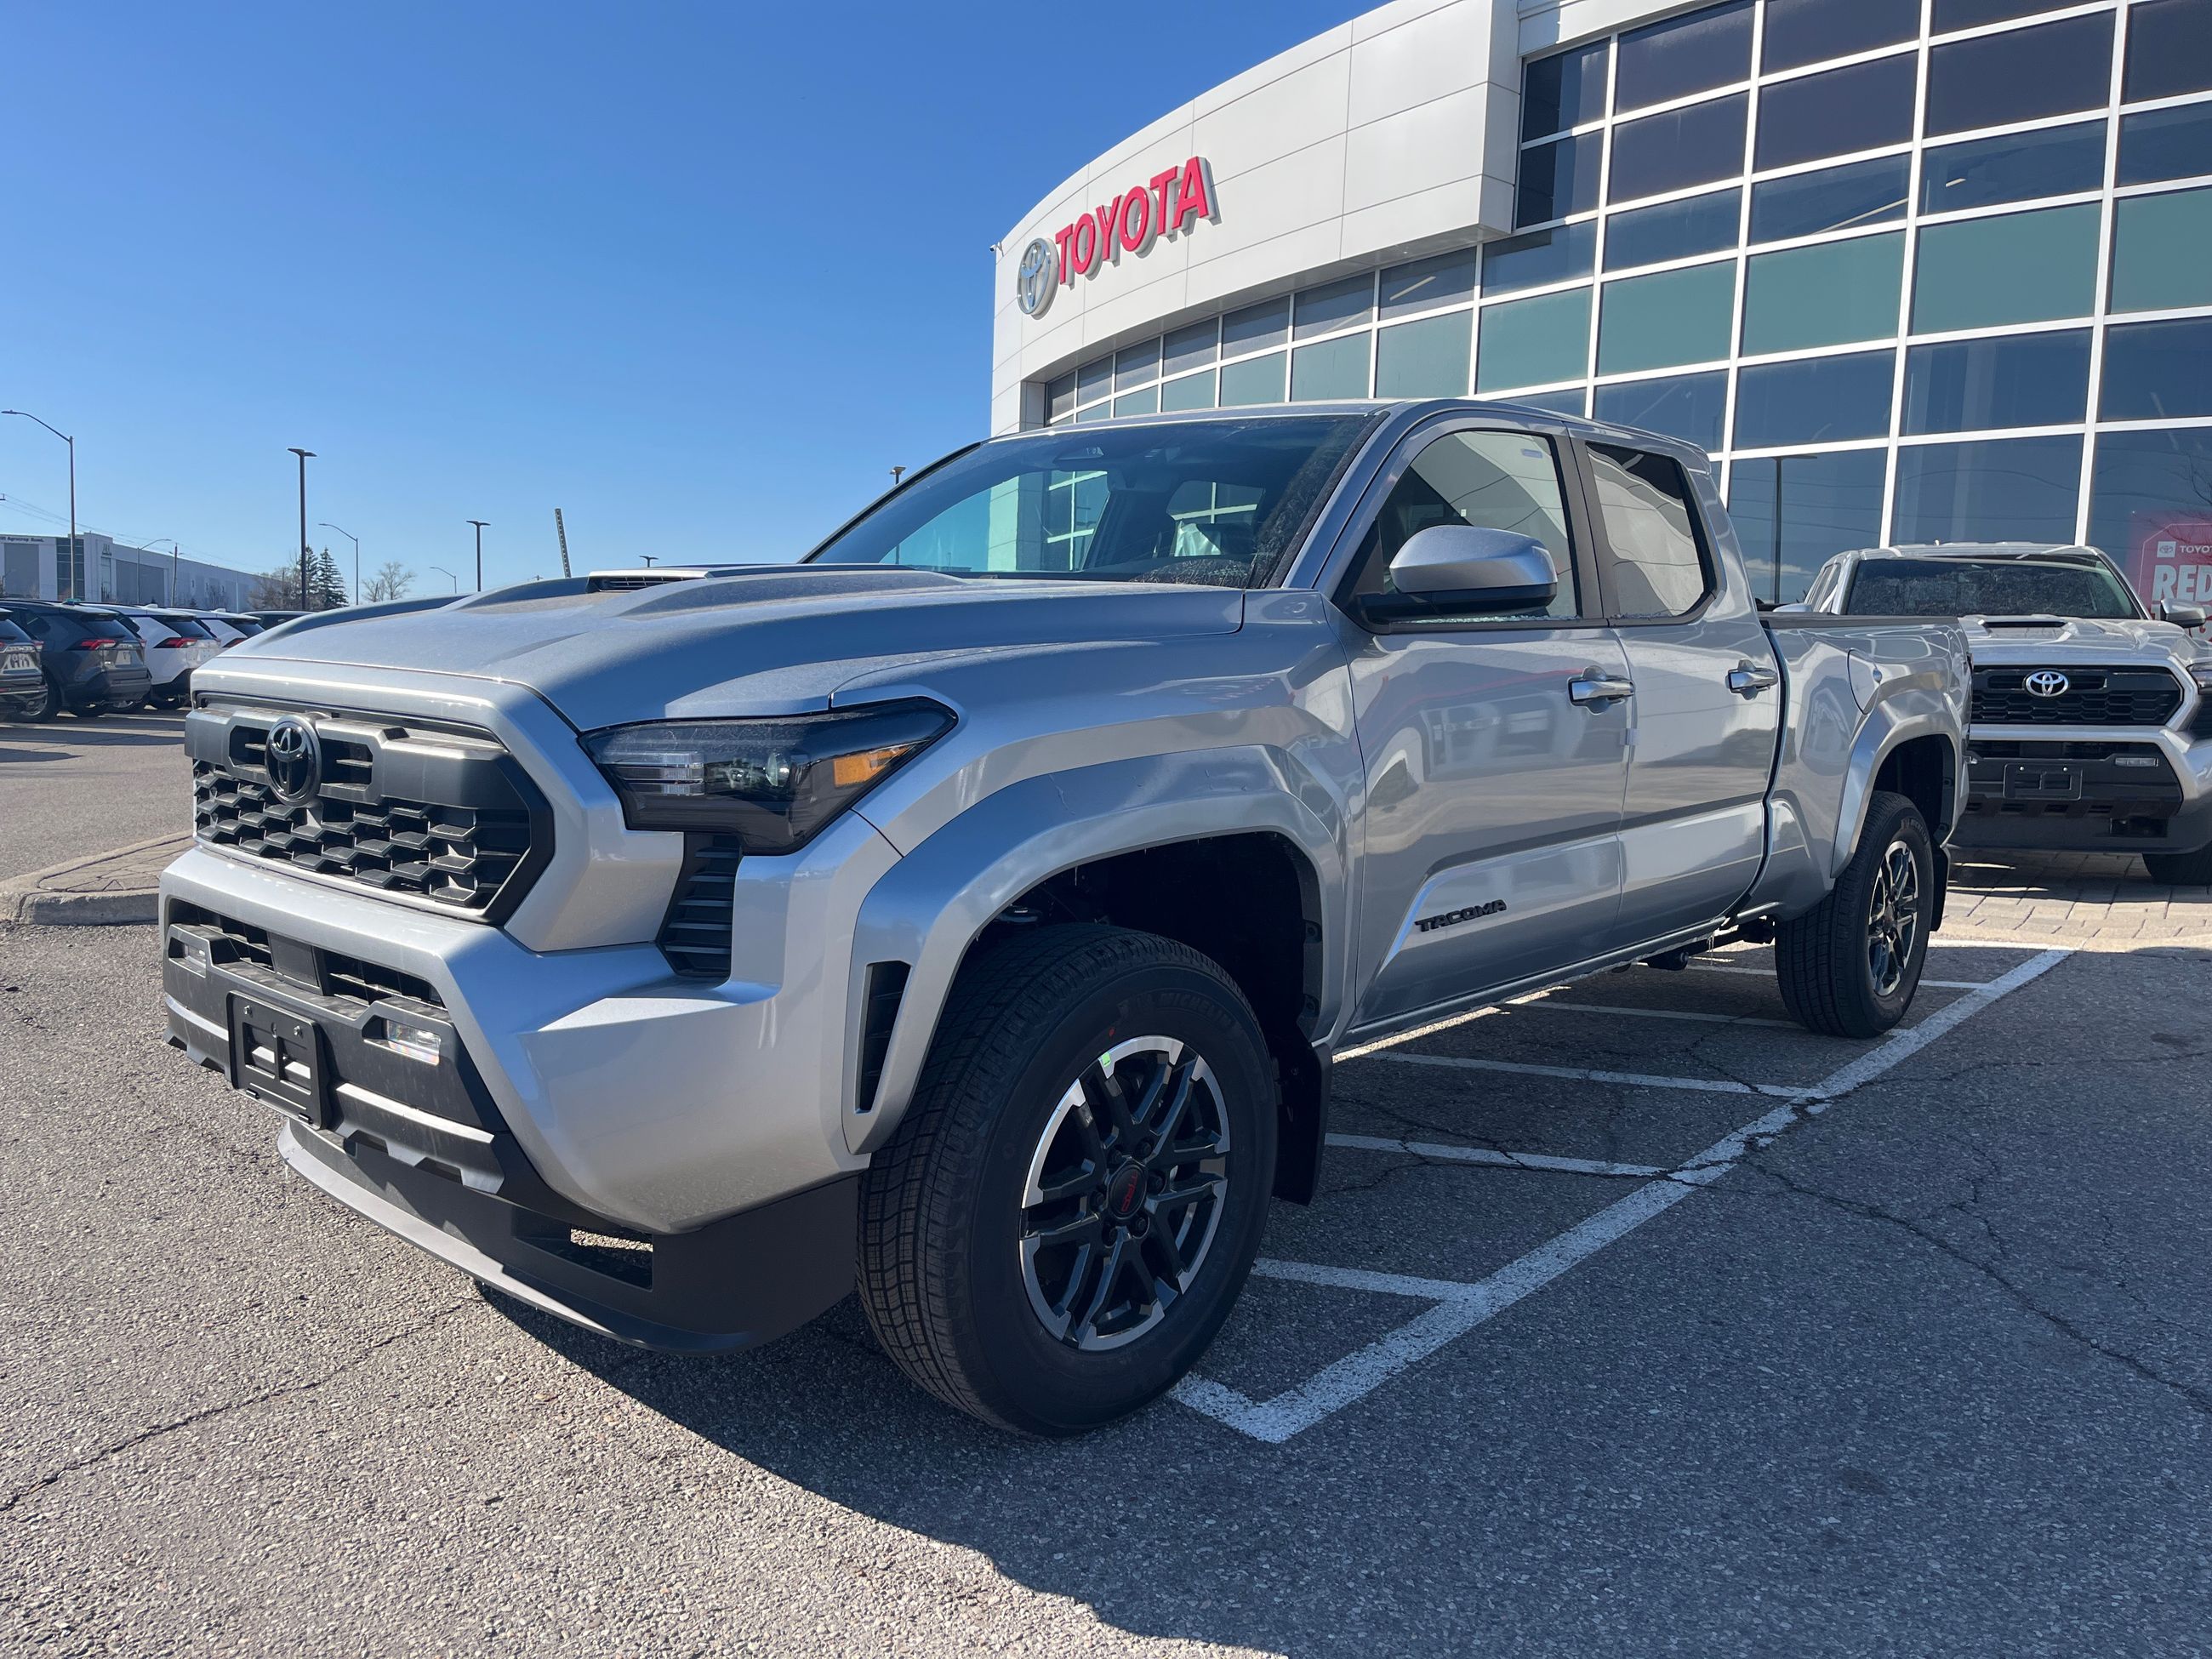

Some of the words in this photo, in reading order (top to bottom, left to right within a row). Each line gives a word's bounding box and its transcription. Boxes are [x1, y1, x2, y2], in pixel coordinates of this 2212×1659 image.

[1055, 156, 1211, 287] TOYOTA
[2180, 545, 2212, 554] TOYO
[2152, 565, 2212, 601] RED
[1414, 899, 1507, 932] TACOMA
[1121, 1170, 1137, 1212] TRD
